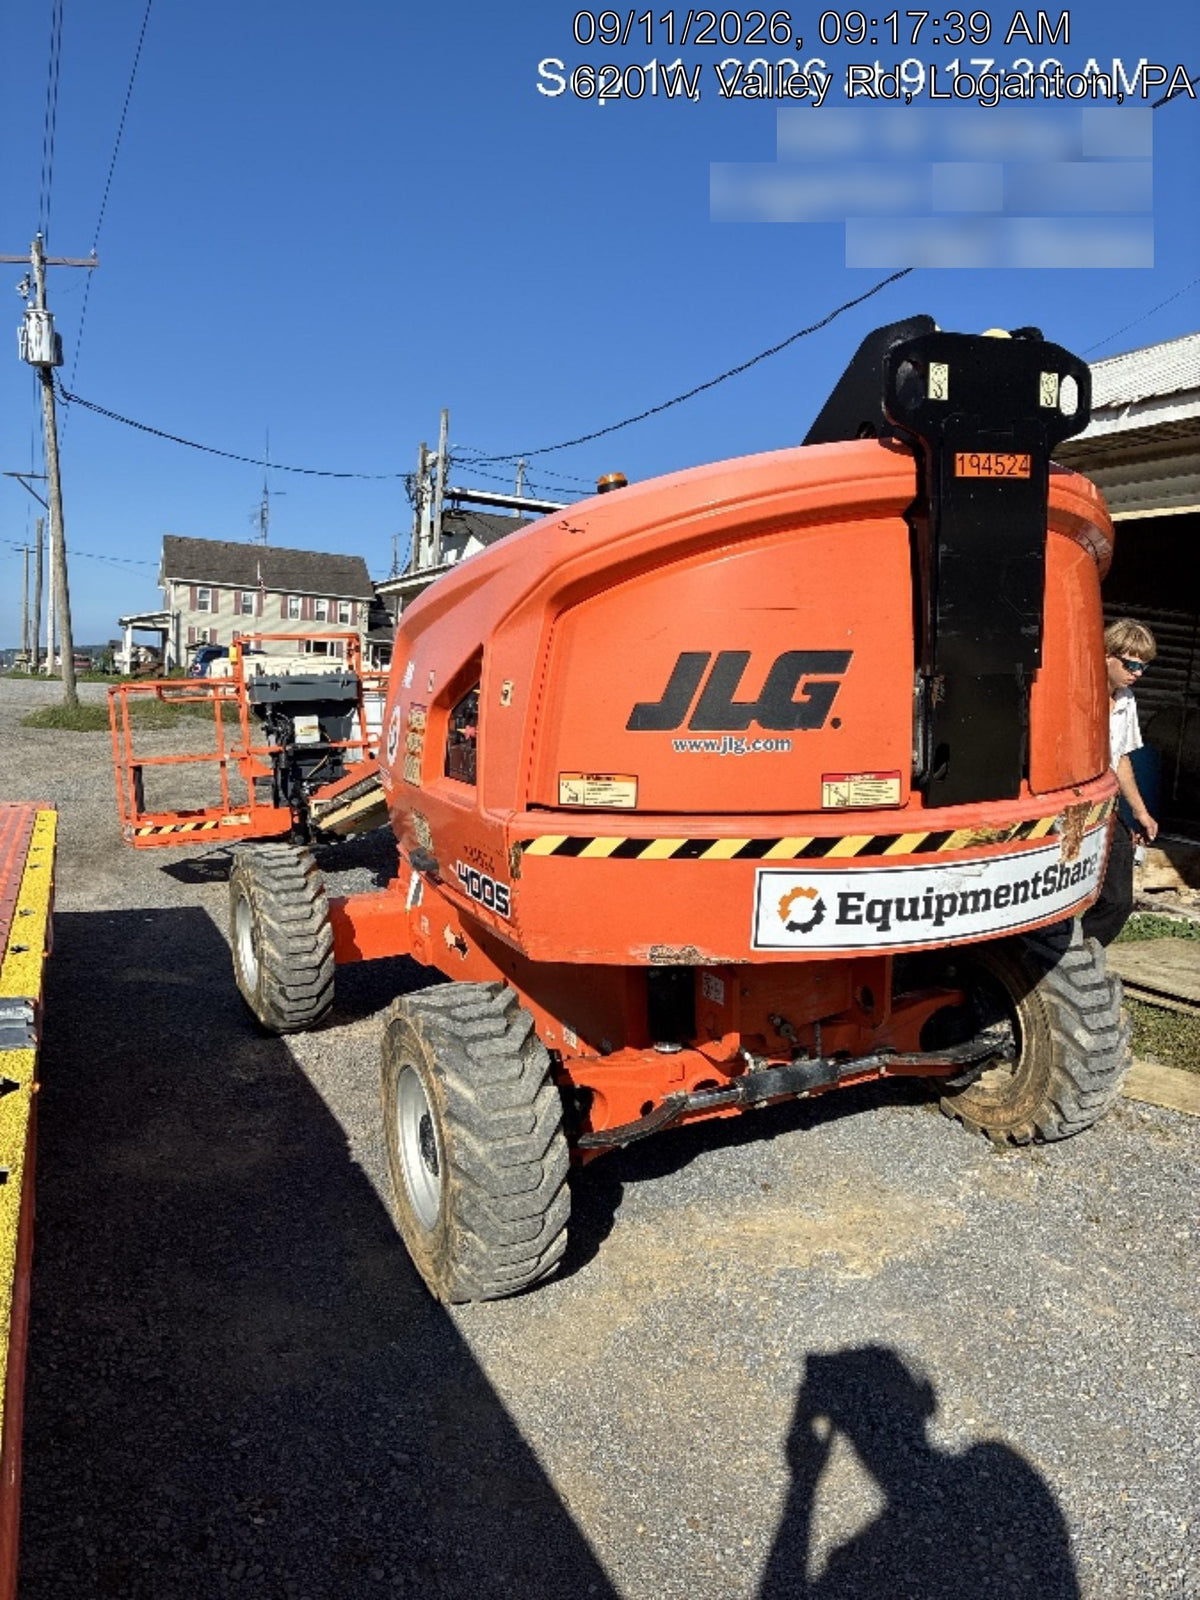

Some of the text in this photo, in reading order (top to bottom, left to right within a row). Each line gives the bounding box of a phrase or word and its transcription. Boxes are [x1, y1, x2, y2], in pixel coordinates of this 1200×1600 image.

[957, 454, 1030, 477] 194524
[672, 736, 792, 755] www.jlg.com
[834, 853, 1098, 932] EquipmentShare
